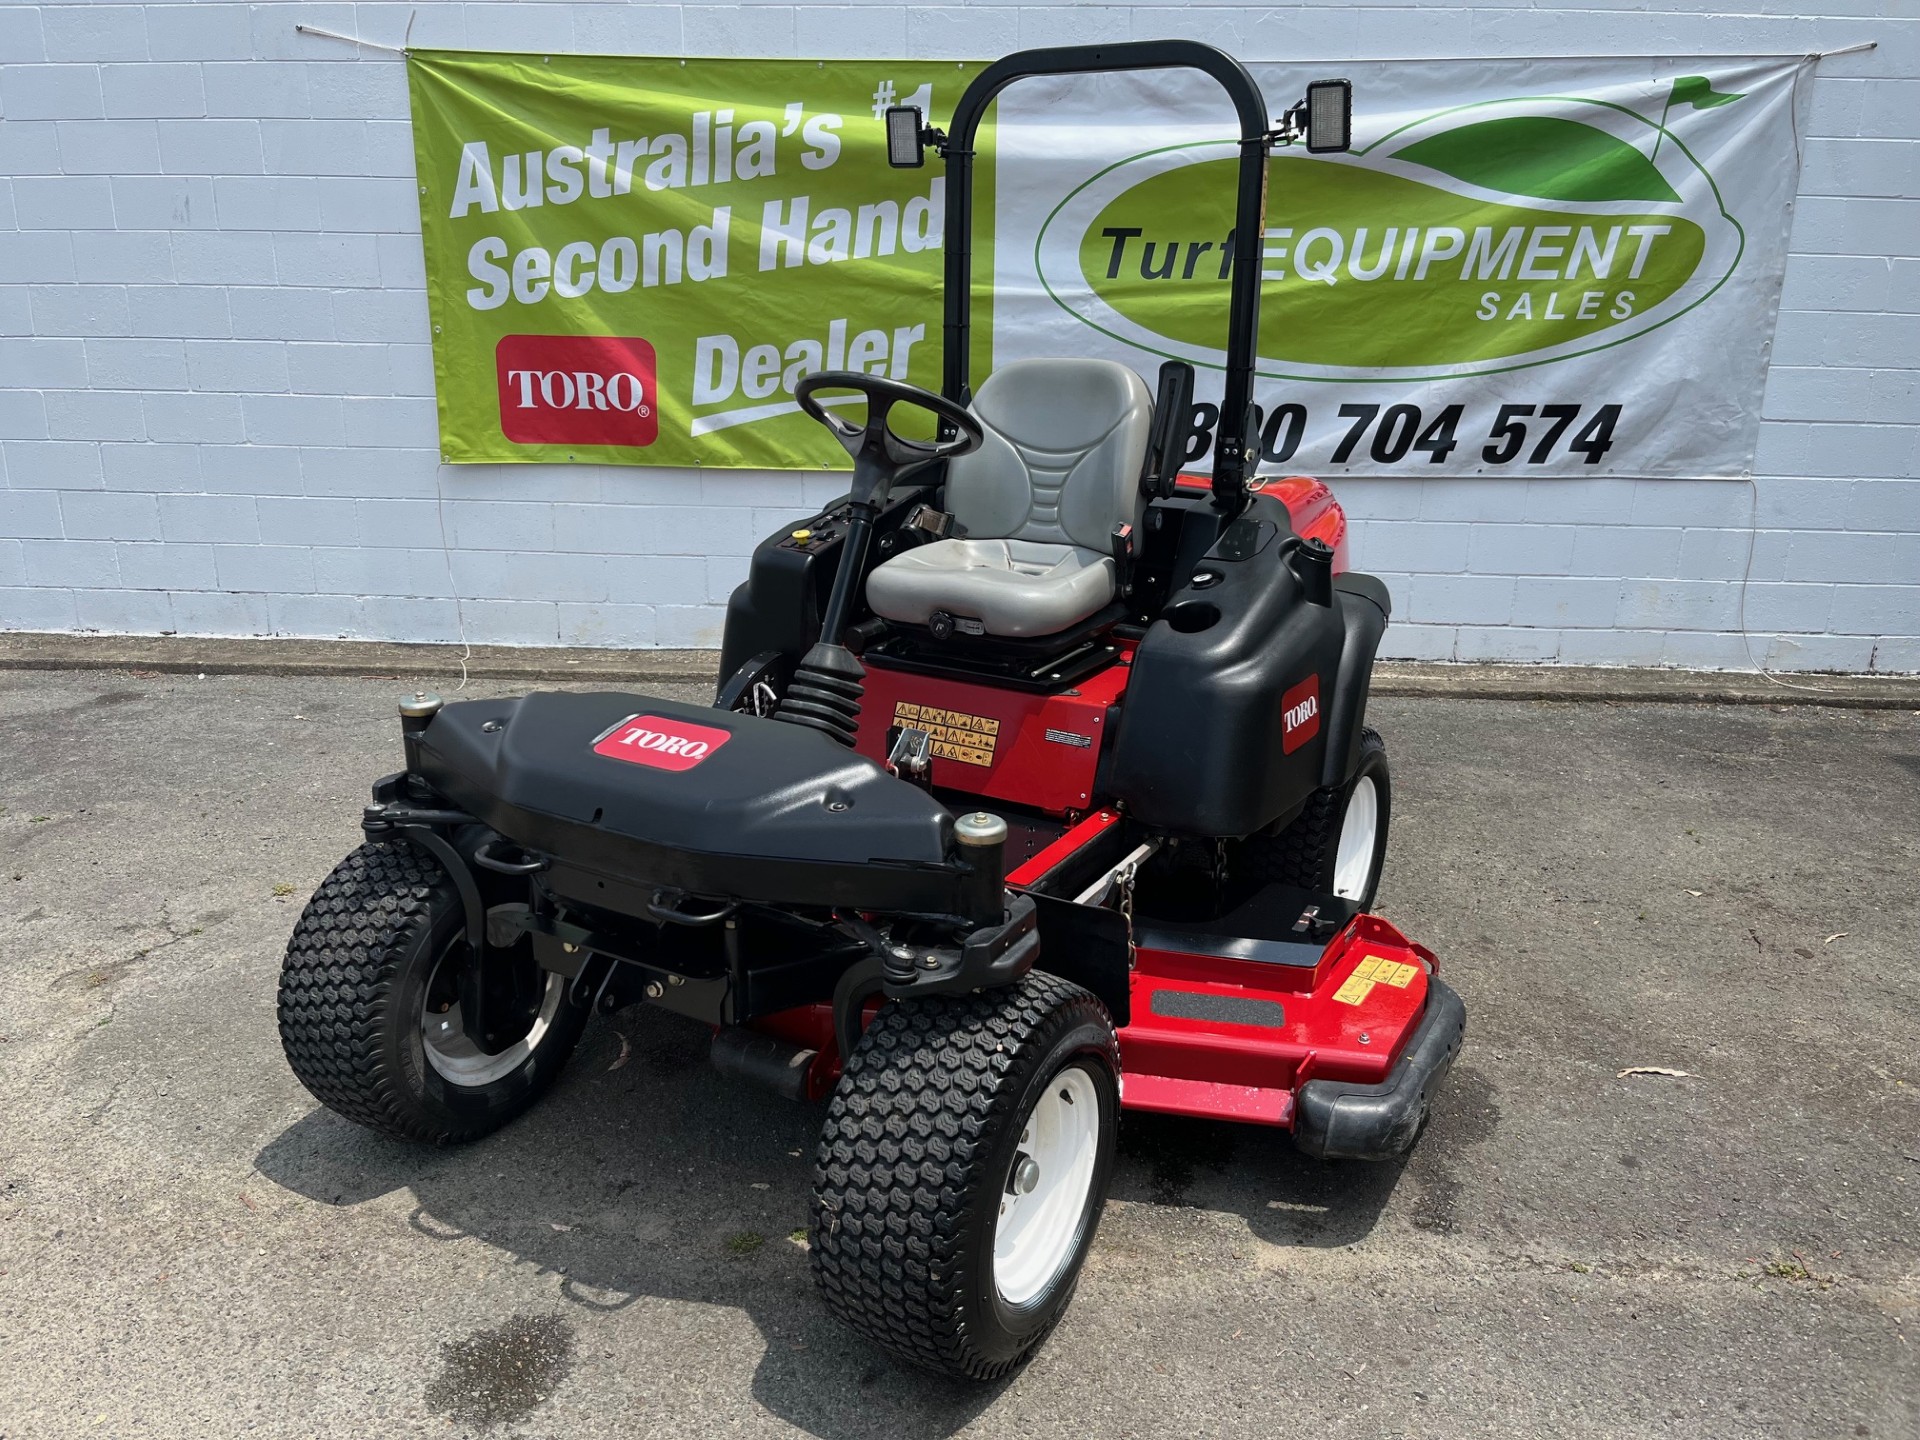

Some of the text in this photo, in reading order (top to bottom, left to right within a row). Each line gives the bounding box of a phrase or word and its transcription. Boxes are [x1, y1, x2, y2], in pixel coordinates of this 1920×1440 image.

[449, 102, 843, 218] Australia's
[467, 176, 946, 310] Second Hand
[1476, 291, 1636, 321] SALES
[692, 318, 926, 406] Dealer
[1330, 404, 1465, 464] 704
[1481, 404, 1624, 465] 574
[618, 727, 709, 759] TORO
[1284, 696, 1318, 733] TORO
